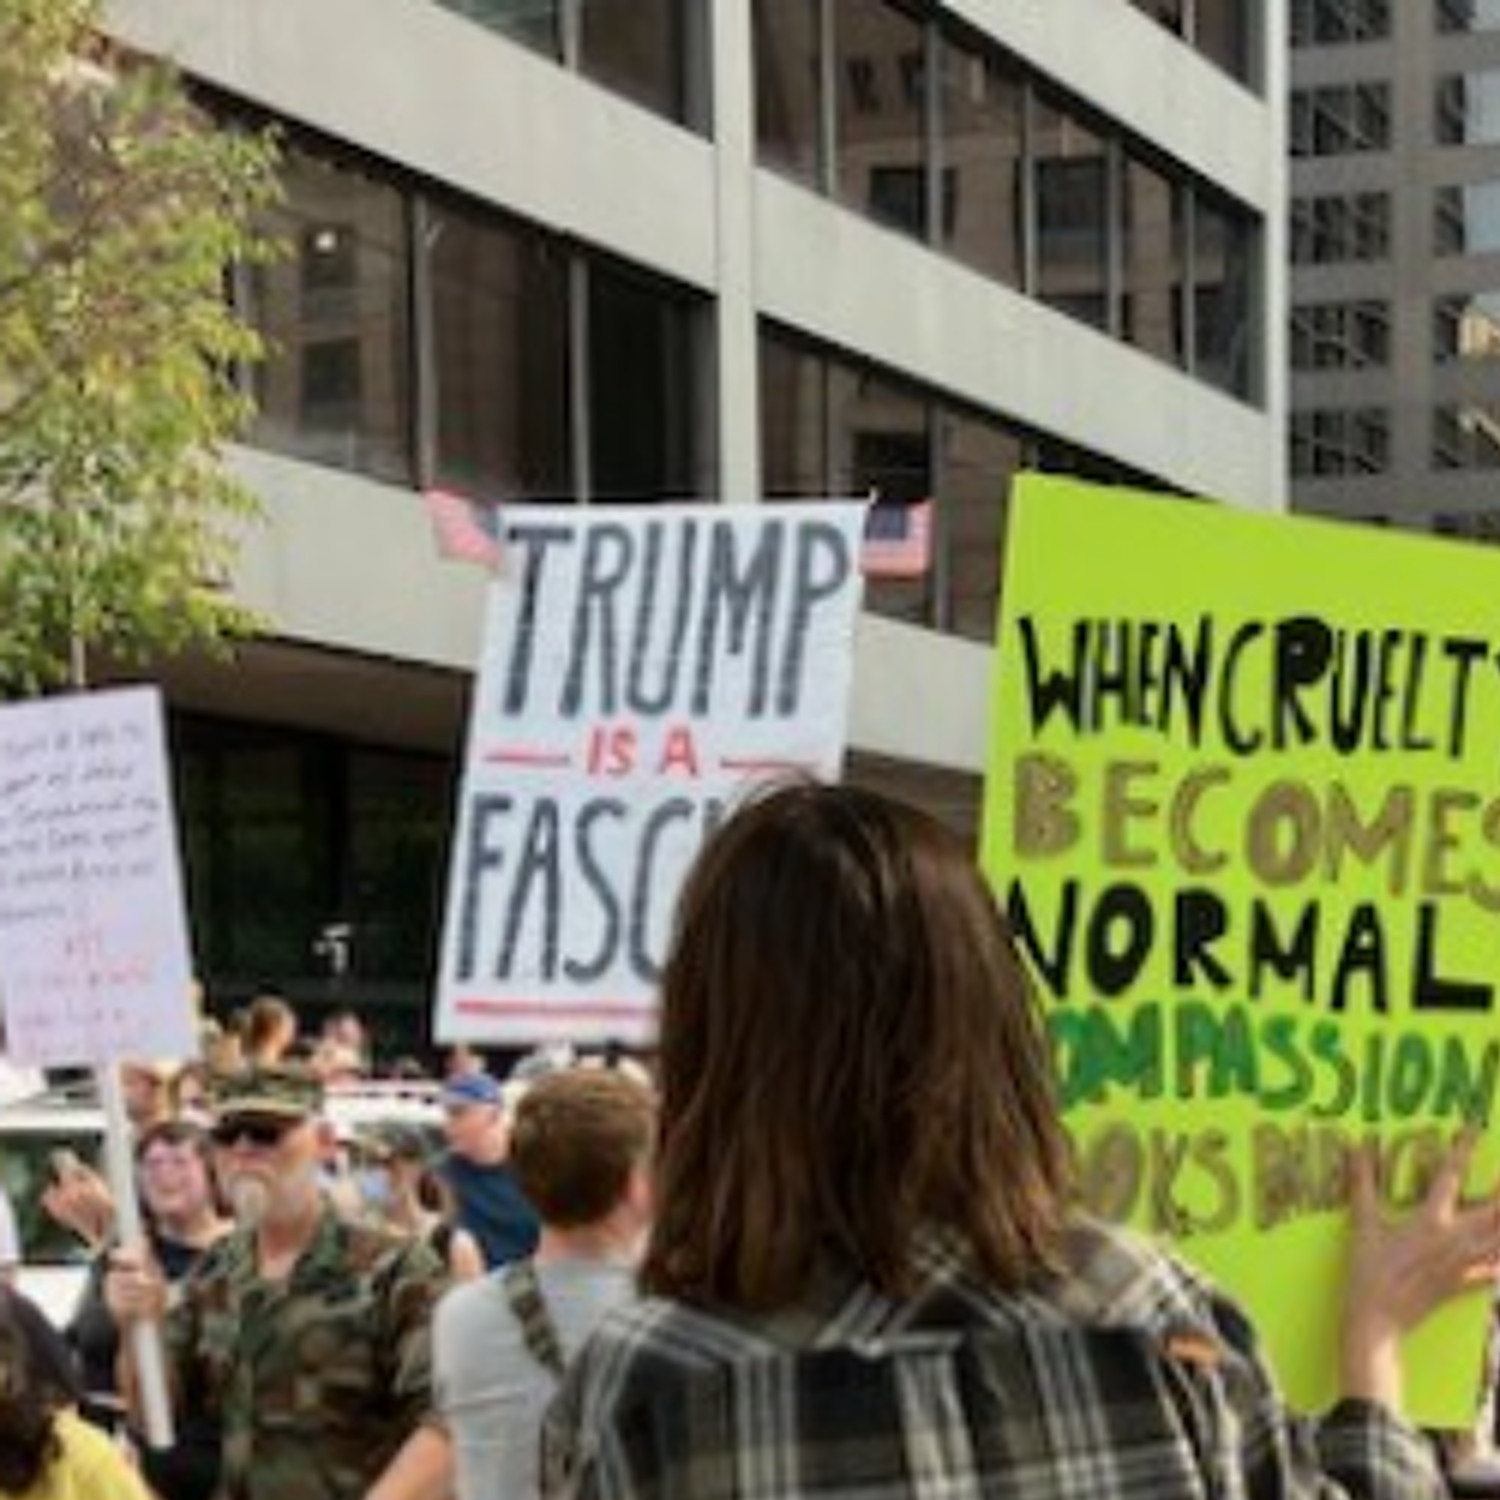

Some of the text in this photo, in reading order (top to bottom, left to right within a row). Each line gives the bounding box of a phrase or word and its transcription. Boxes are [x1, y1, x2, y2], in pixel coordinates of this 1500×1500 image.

[504, 517, 851, 720] TRUMP
[586, 727, 698, 777] IS A
[456, 793, 722, 984] FASC
[1006, 876, 1496, 1016] NORMAL
